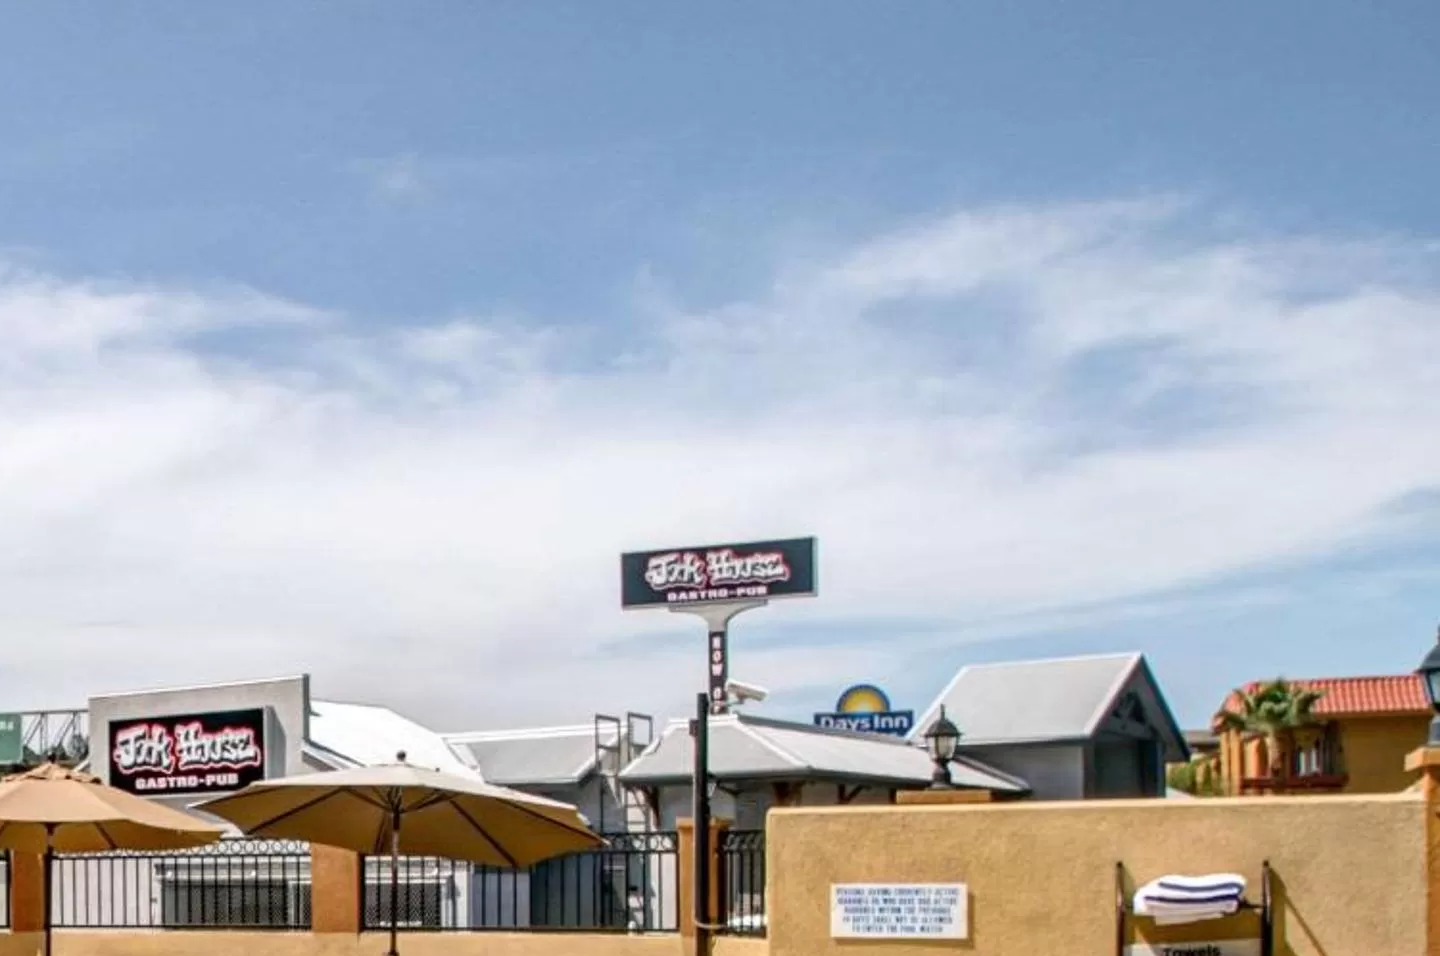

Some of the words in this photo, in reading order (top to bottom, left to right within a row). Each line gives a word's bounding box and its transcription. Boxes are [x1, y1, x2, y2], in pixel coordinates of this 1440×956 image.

[667, 585, 768, 602] GASTRO-PUB
[820, 716, 871, 732] Days
[873, 714, 908, 729] Inn
[135, 773, 239, 790] GASTRO-PUB
